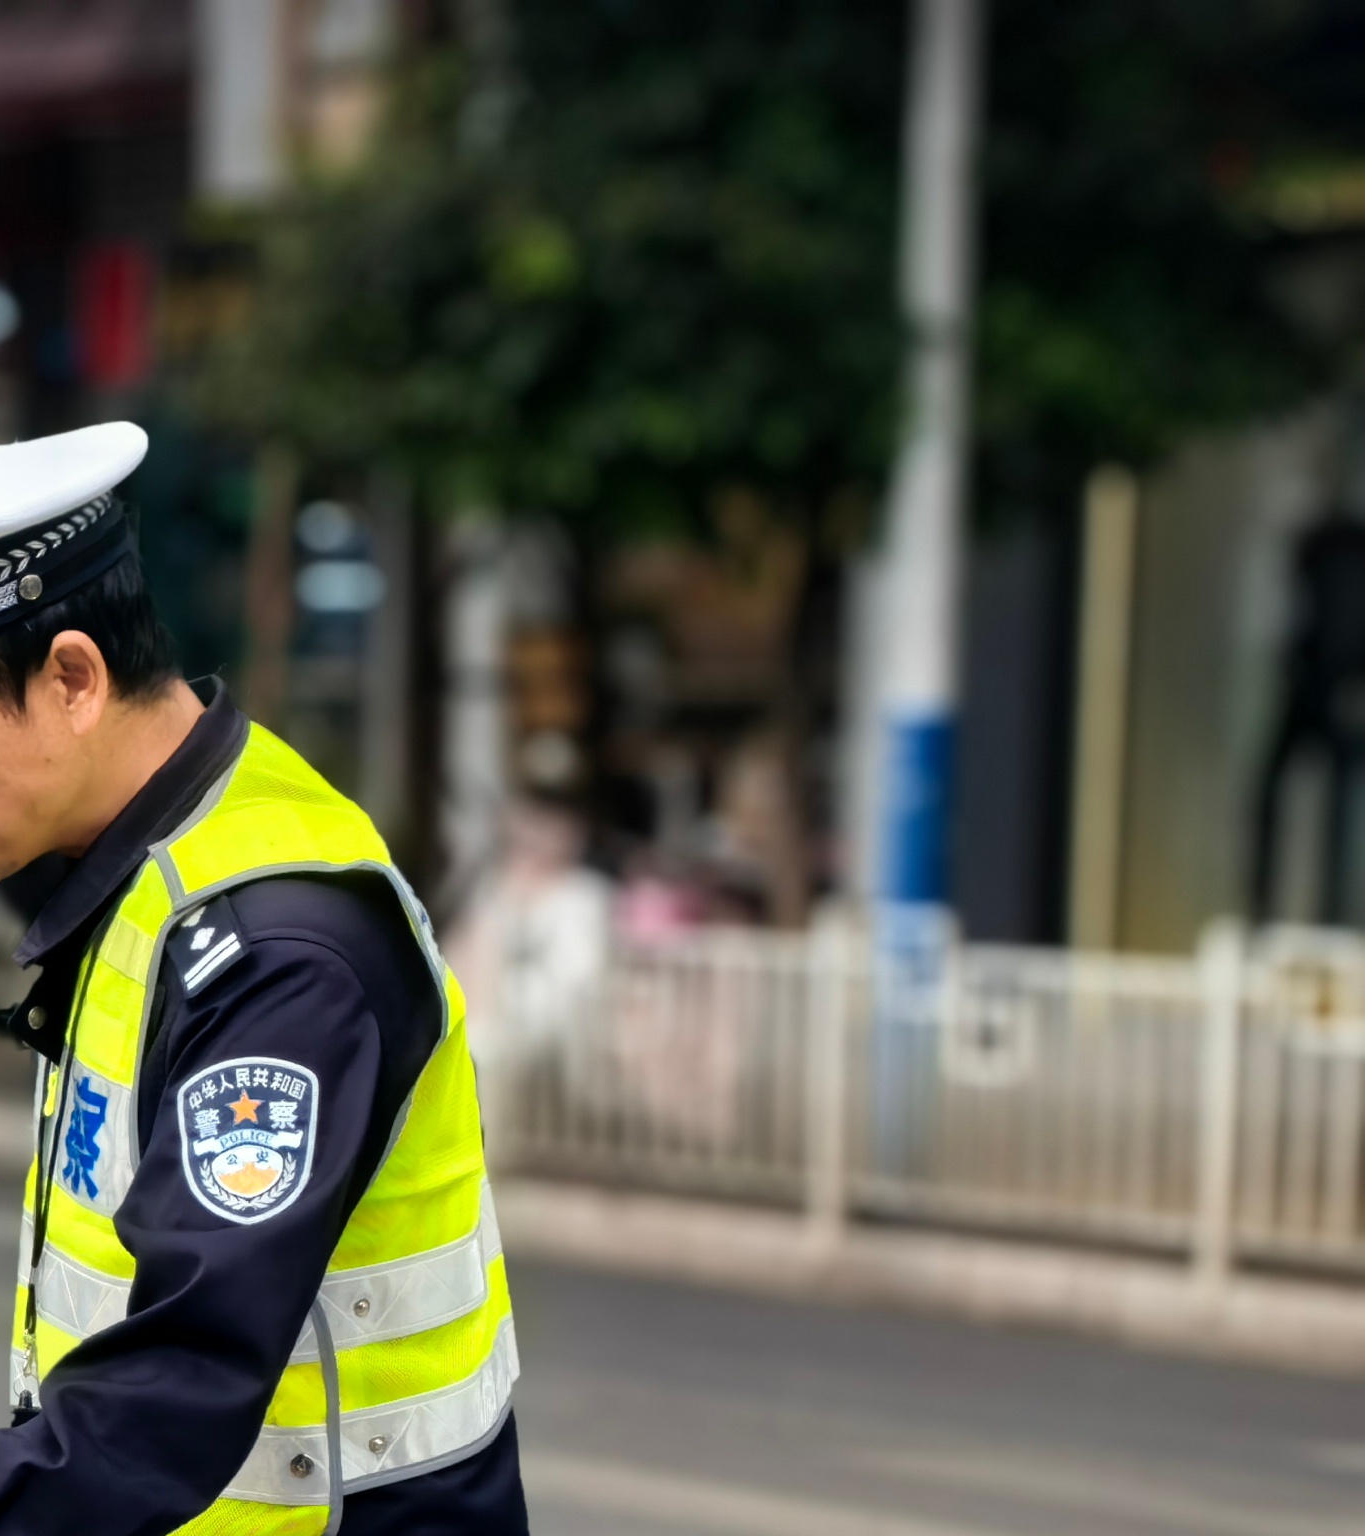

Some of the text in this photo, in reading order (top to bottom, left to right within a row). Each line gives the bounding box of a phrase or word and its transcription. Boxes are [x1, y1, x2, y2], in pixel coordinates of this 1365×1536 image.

[189, 1067, 307, 1109] 中华人民共和国
[220, 1131, 275, 1149] POLICE
